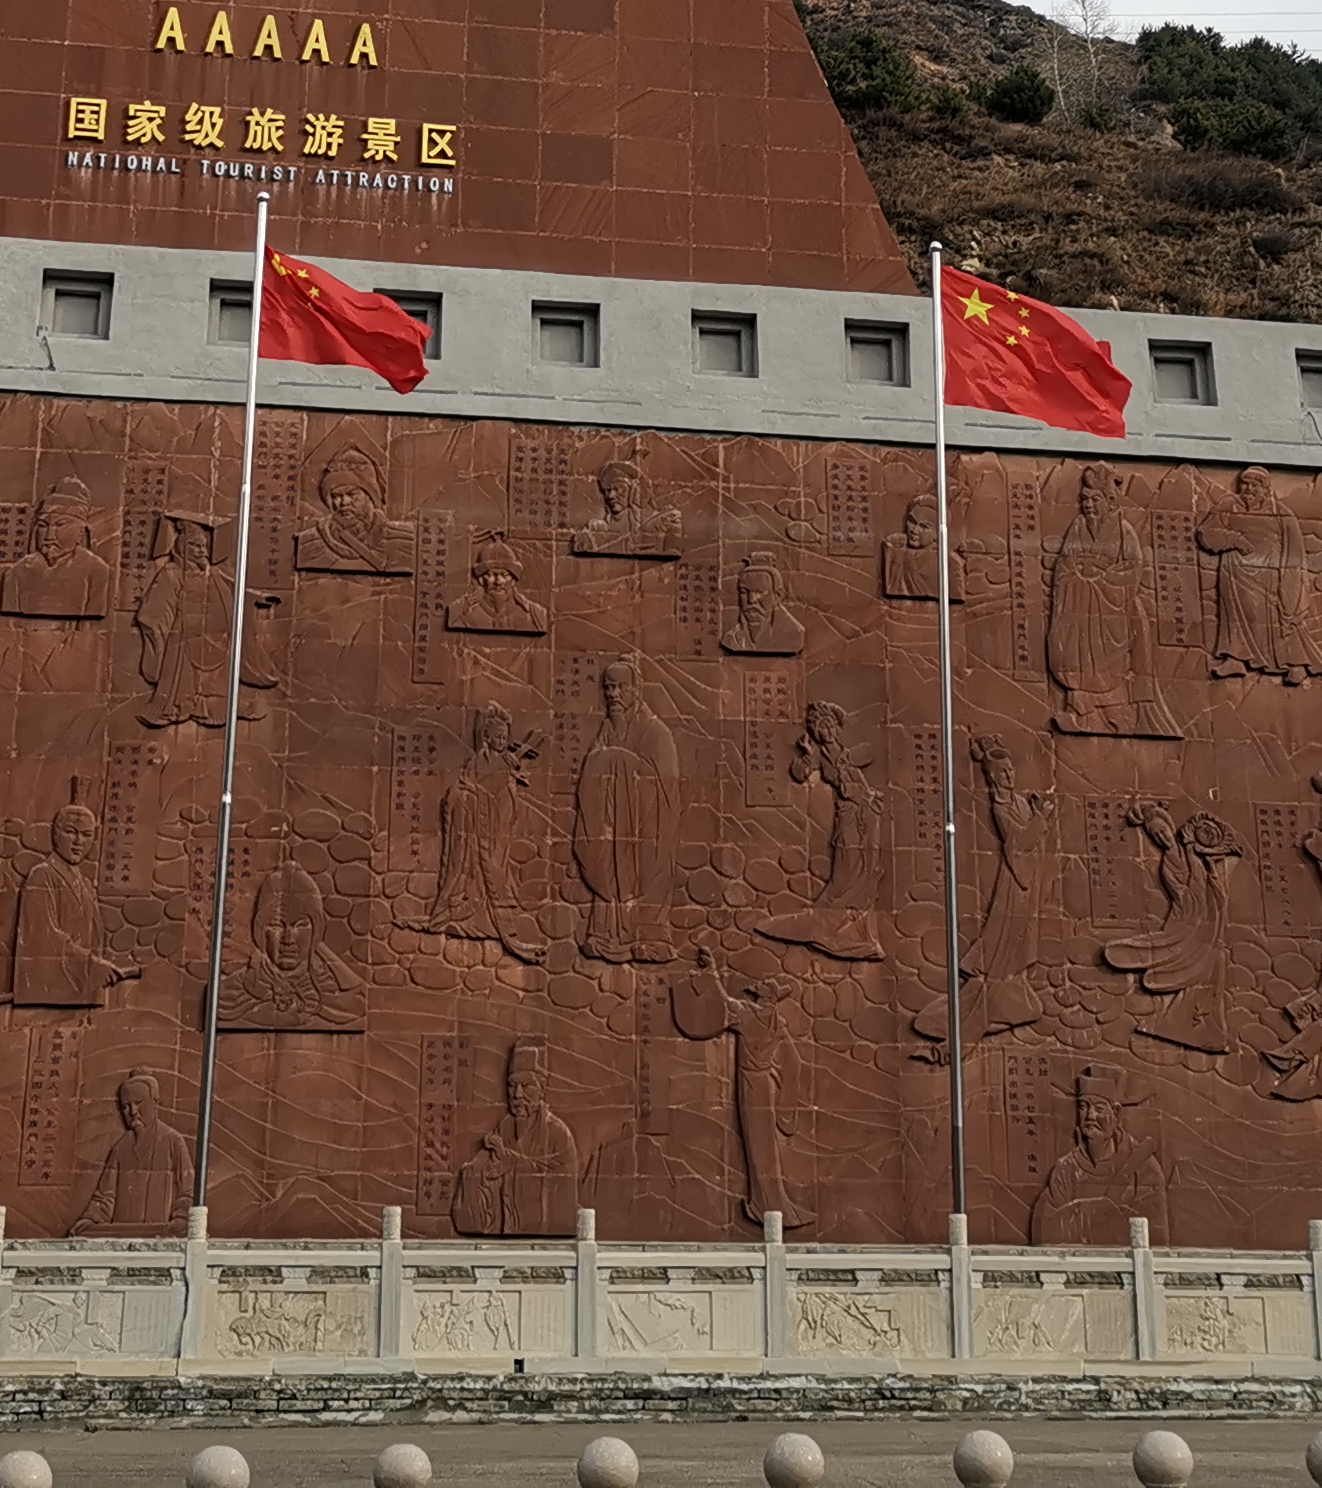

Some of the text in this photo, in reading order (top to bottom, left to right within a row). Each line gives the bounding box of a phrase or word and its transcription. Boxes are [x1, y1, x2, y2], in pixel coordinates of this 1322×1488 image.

[67, 97, 457, 167] 国家级旅游景区
[67, 151, 455, 194] NATIONAL TOURIST ATTRACTION
